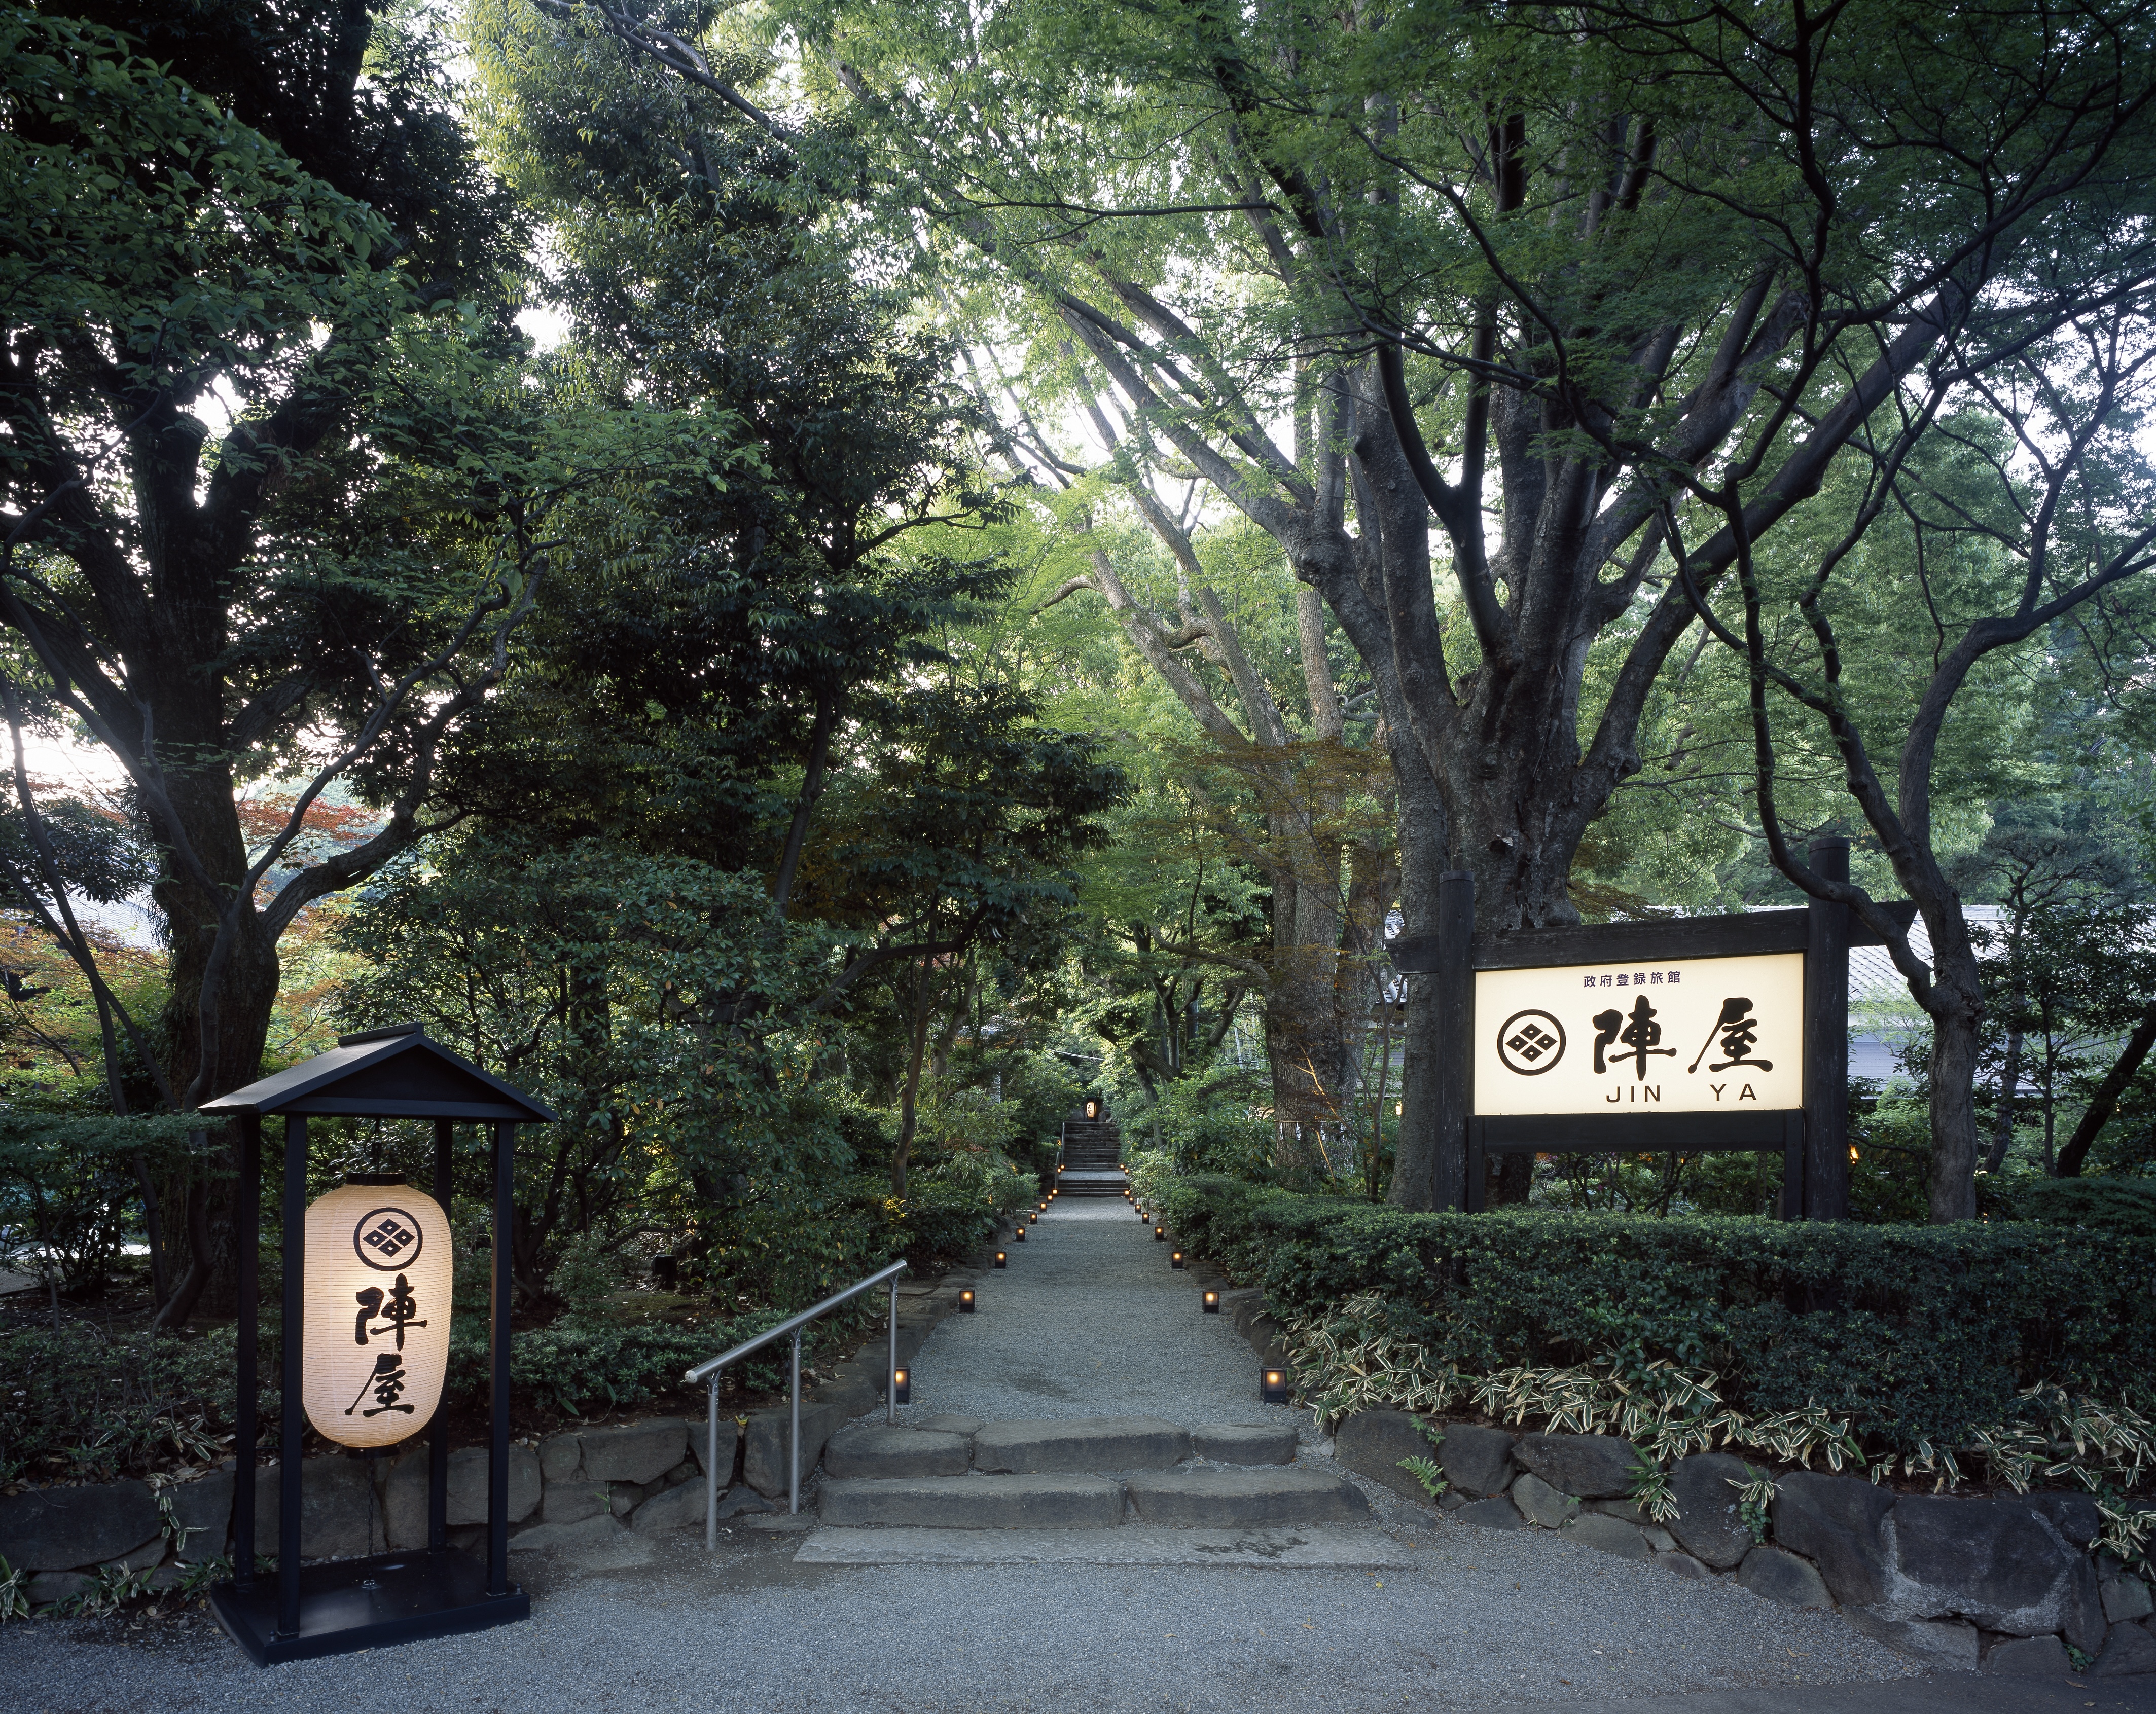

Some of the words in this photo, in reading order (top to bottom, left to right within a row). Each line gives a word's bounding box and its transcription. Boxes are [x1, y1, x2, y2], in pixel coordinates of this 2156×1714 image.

[1584, 970, 1681, 988] 政府登録旅館
[1592, 995, 1773, 1081] 陣屋
[1606, 1085, 1661, 1103] JIN
[1710, 1083, 1757, 1101] YA
[345, 1273, 428, 1417] 陣屋
